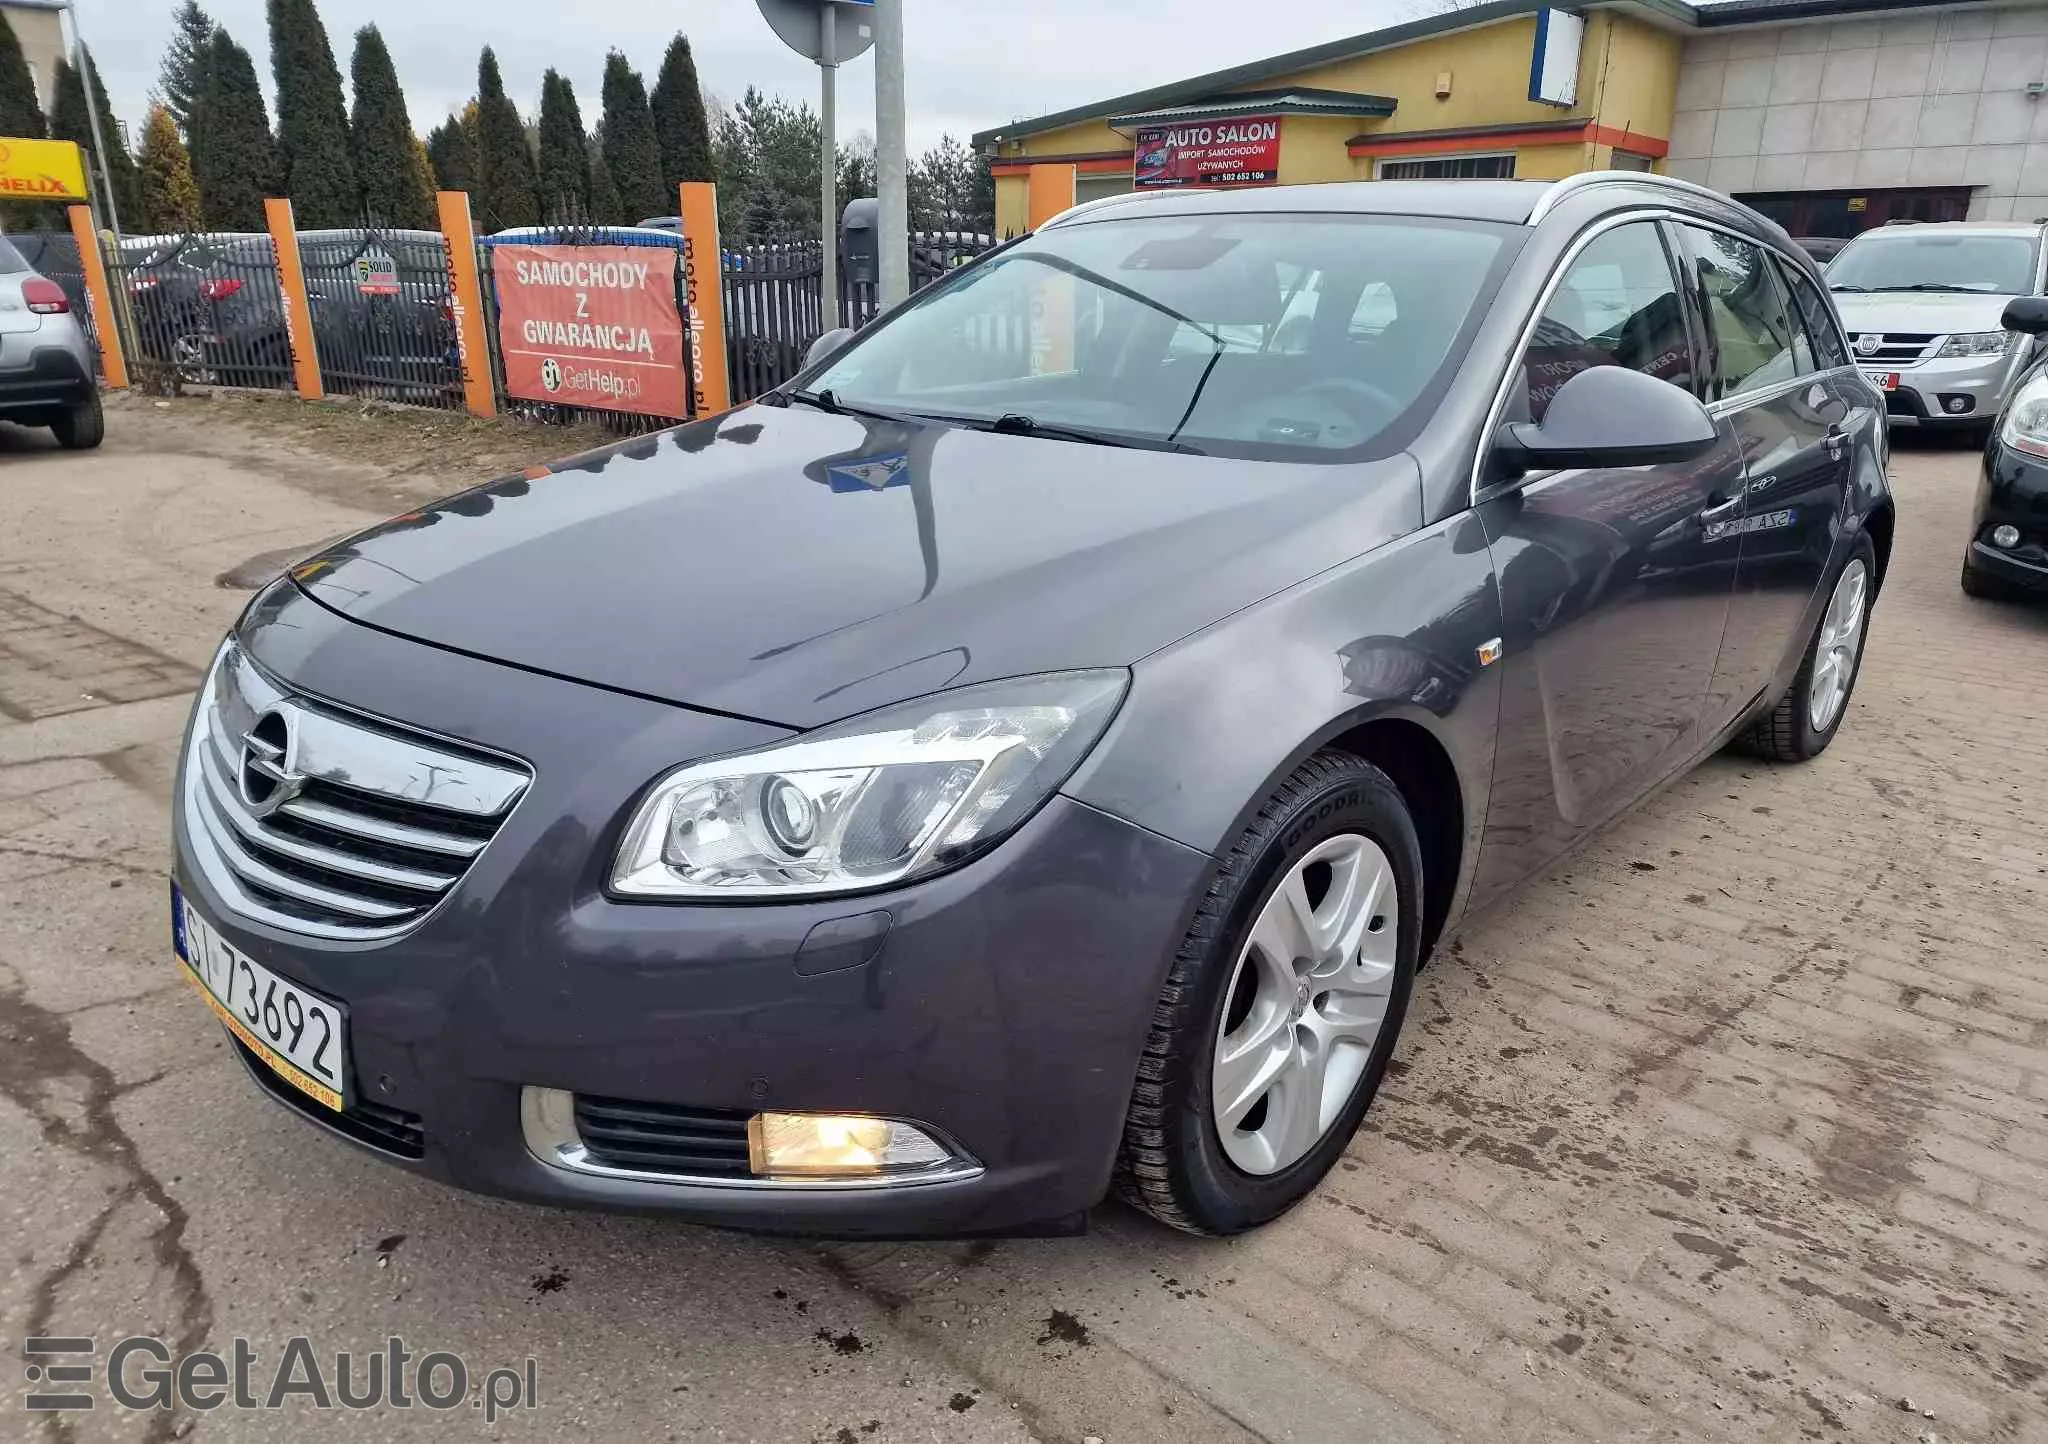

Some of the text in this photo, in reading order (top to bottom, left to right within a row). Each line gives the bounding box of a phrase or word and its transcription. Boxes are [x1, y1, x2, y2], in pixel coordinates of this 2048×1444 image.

[1165, 127, 1213, 147] AUTO
[1215, 121, 1277, 144] SALON
[1178, 145, 1266, 160] IMPORT SAMOCHODÓW
[1197, 159, 1244, 171] UŻYWANYCH
[1222, 172, 1236, 181] 502
[1237, 172, 1250, 181] 652
[1252, 170, 1265, 180] 106
[369, 261, 393, 273] SOLID
[516, 260, 649, 290] SAMOCHODY
[575, 293, 590, 318] Z
[523, 319, 655, 360] GWARANCJĄ
[563, 366, 641, 399] GetHelp.pl
[188, 906, 211, 986] SI
[220, 941, 334, 1081] 73692
